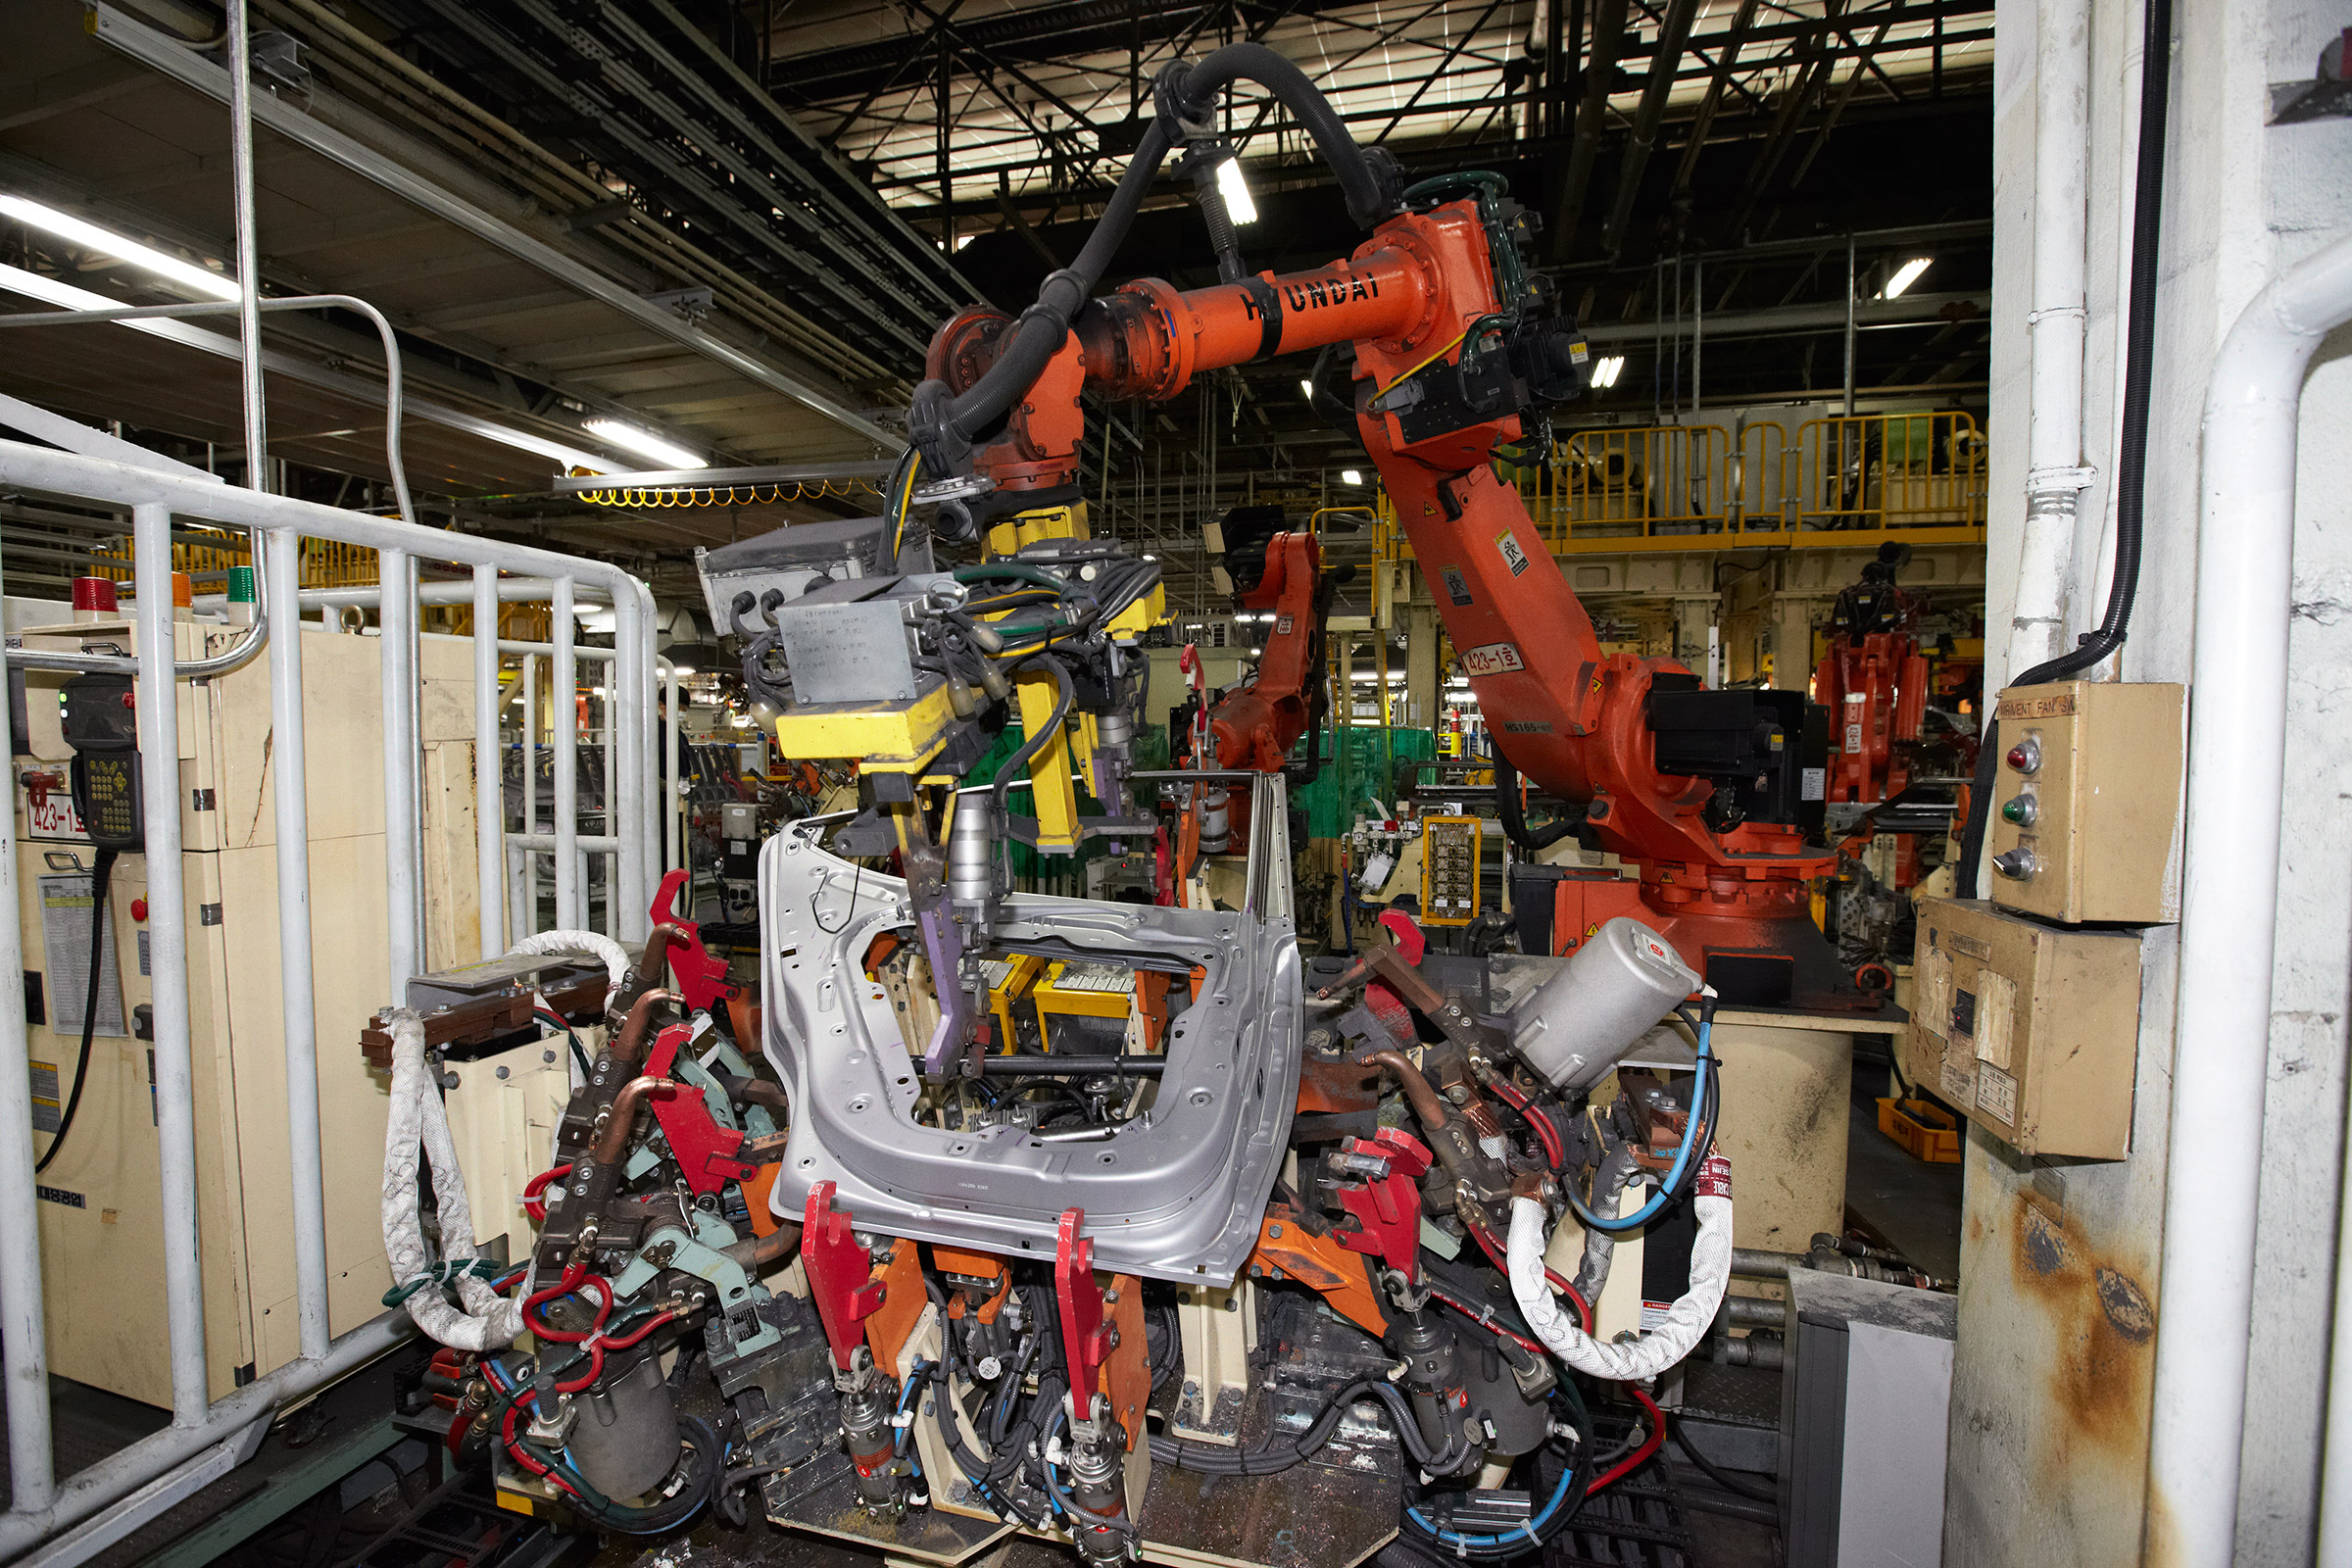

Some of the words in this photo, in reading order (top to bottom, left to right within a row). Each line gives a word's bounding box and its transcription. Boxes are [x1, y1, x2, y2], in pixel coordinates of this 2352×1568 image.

[1240, 272, 1379, 320] HUNDAI
[1469, 647, 1517, 671] 423-1호
[2037, 699, 2055, 714] FAN
[37, 1185, 82, 1207] 대중공업
